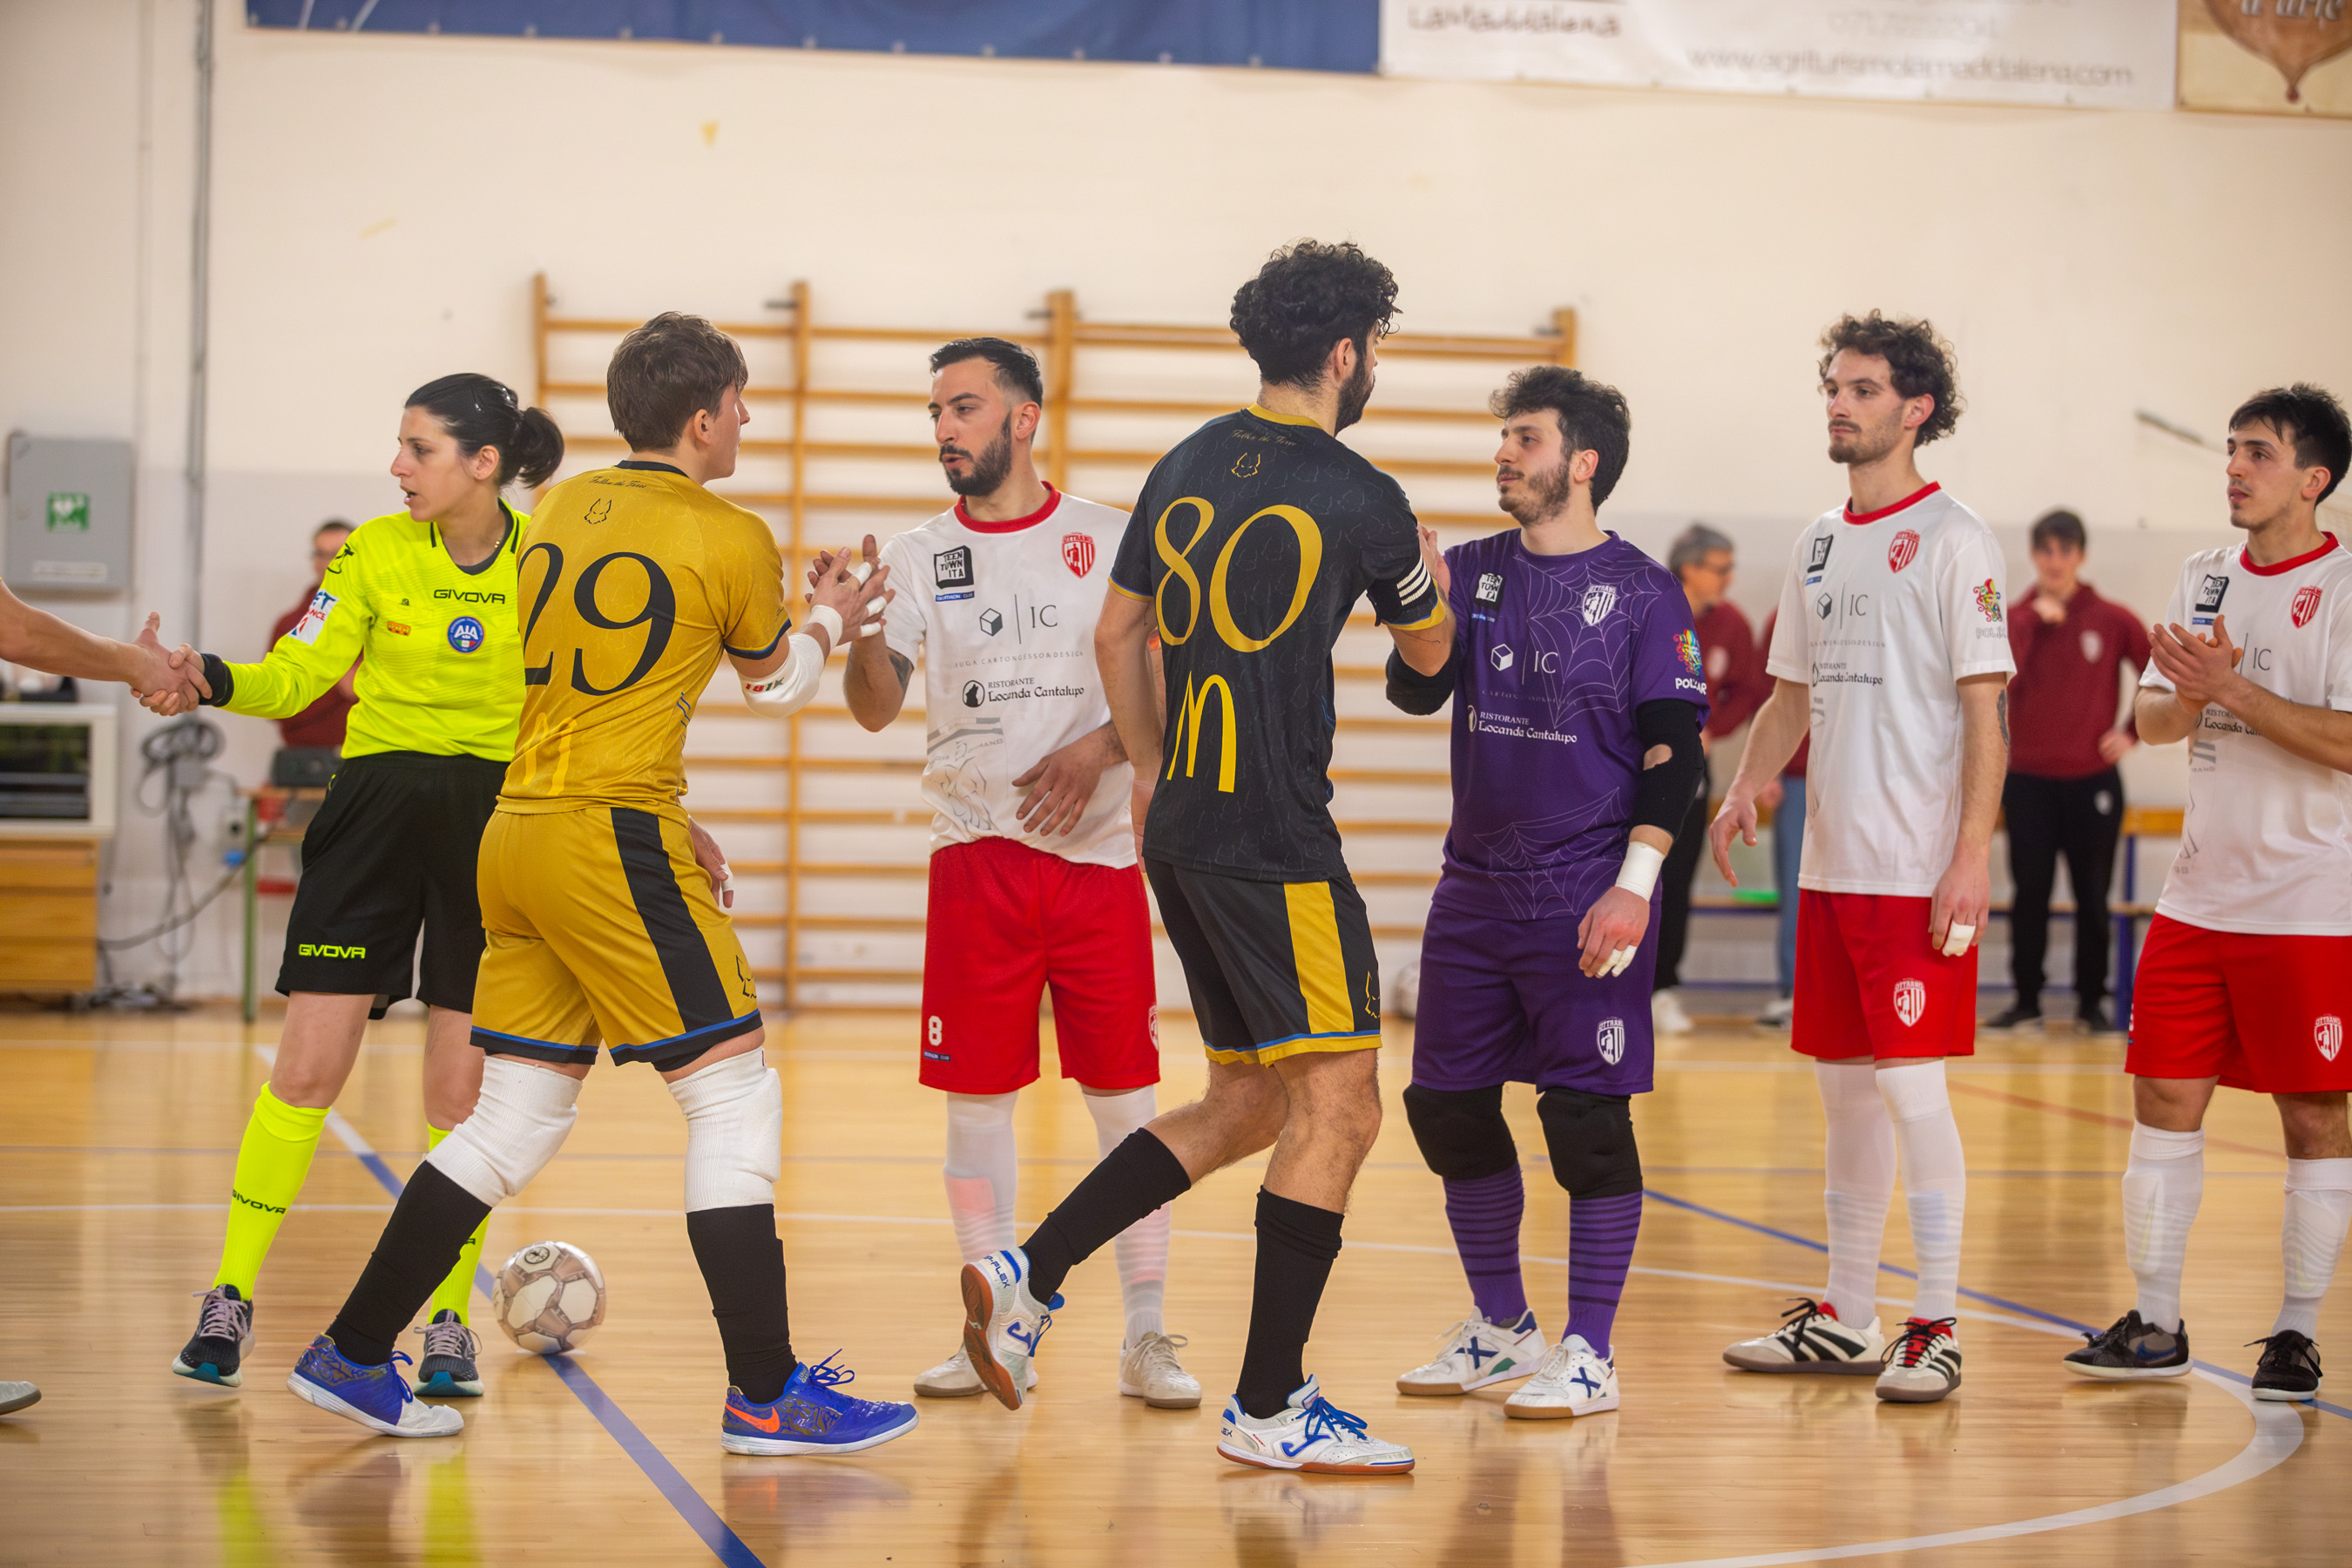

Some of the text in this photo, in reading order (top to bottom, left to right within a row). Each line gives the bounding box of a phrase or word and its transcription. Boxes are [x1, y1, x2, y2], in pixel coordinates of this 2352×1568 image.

[940, 559, 963, 571] TOWN
[943, 551, 963, 563] TEEN
[949, 568, 963, 578] ITA
[1154, 496, 1322, 652] 80
[434, 589, 505, 605] GIVOVA
[1849, 594, 1868, 616] IC
[517, 542, 676, 696] 29
[1030, 605, 1058, 628] IC
[1533, 651, 1558, 674] IC
[2253, 647, 2272, 671] IC
[988, 677, 1034, 689] RISTORANTE
[988, 686, 1084, 702] Locanda Cantalupo
[1480, 711, 1530, 725] RISTORANTE
[2205, 718, 2242, 733] Locanda
[1478, 720, 1578, 745] Locanda Cantalupo
[299, 943, 366, 959] GIVOVA
[929, 1015, 943, 1046] 8
[232, 1188, 286, 1214] GIVOVA
[983, 1254, 1010, 1289] P-FLEX
